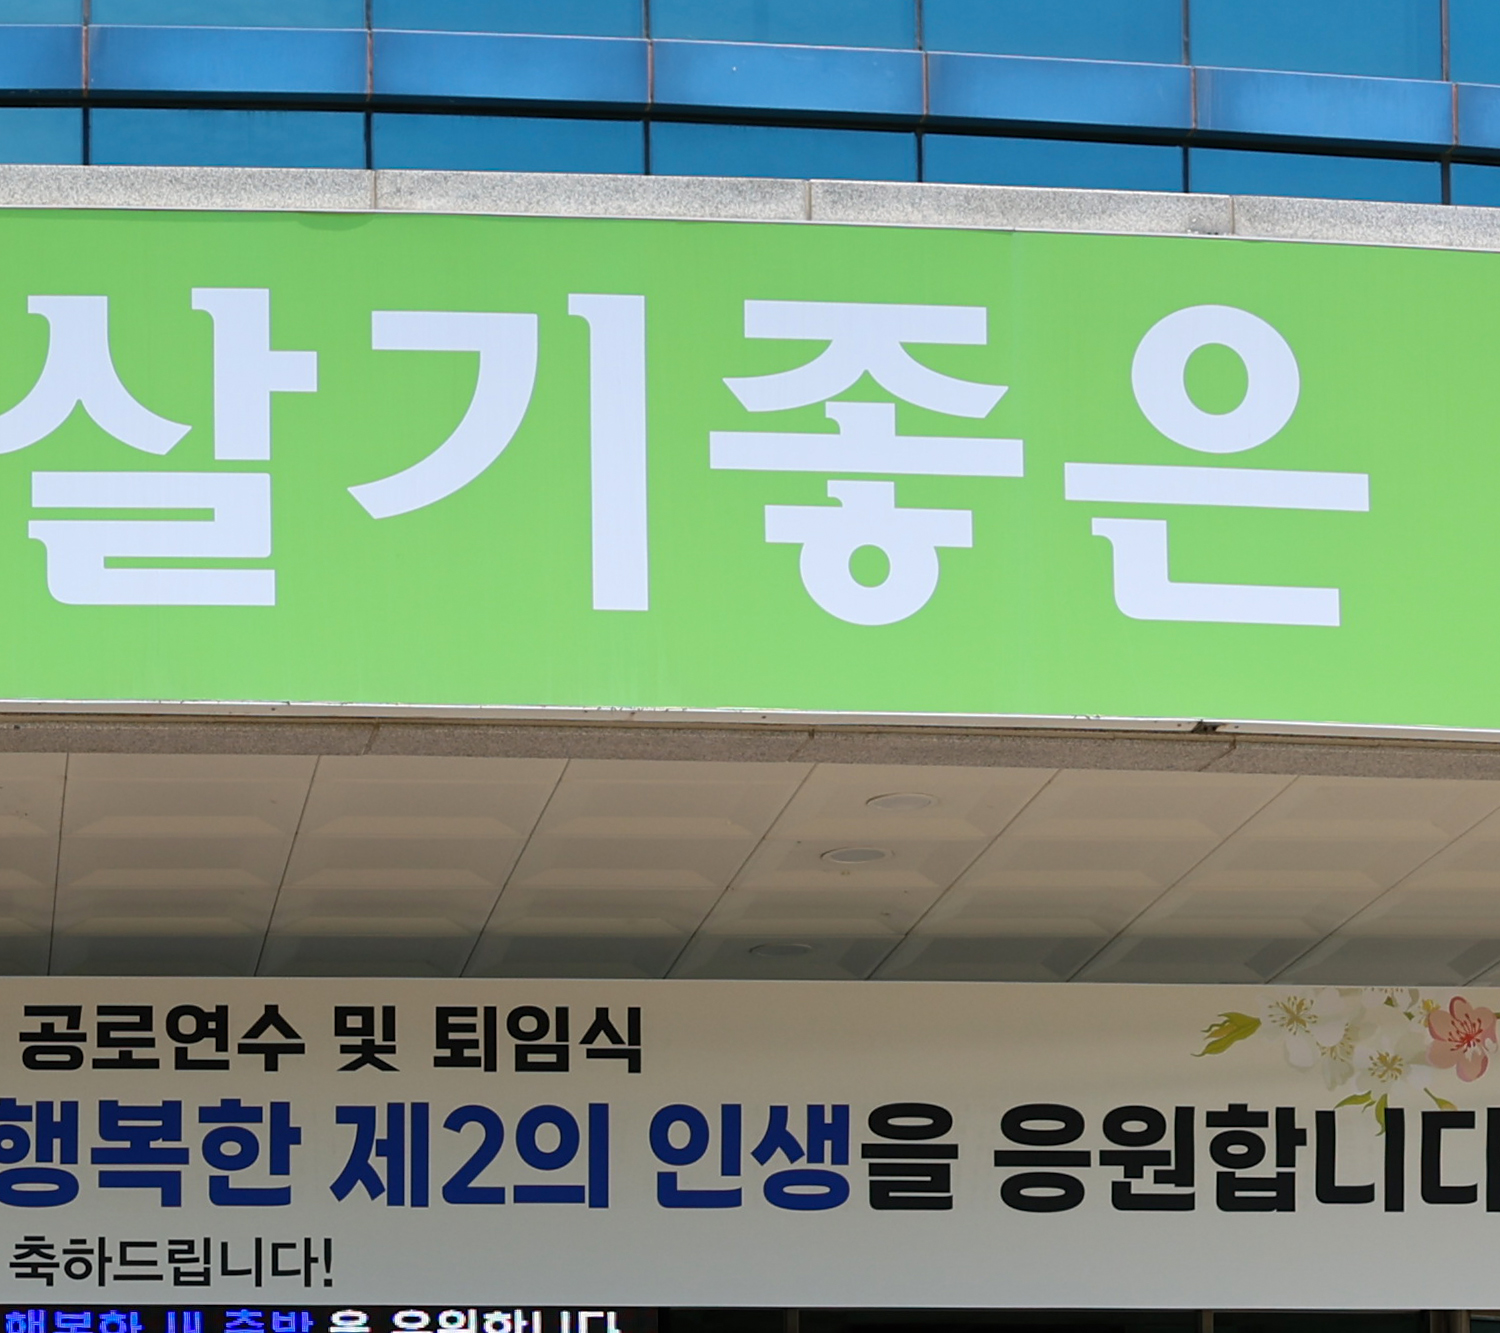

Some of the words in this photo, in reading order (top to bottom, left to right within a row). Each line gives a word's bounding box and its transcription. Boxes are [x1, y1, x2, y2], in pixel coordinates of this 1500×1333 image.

[18, 1004, 306, 1072] 공로연수
[333, 1005, 399, 1072] 및
[433, 1005, 642, 1074] 퇴임식
[329, 1102, 609, 1209] 제2의
[649, 1102, 959, 1211] 인생을
[9, 1235, 333, 1288] 축하드립니다!
